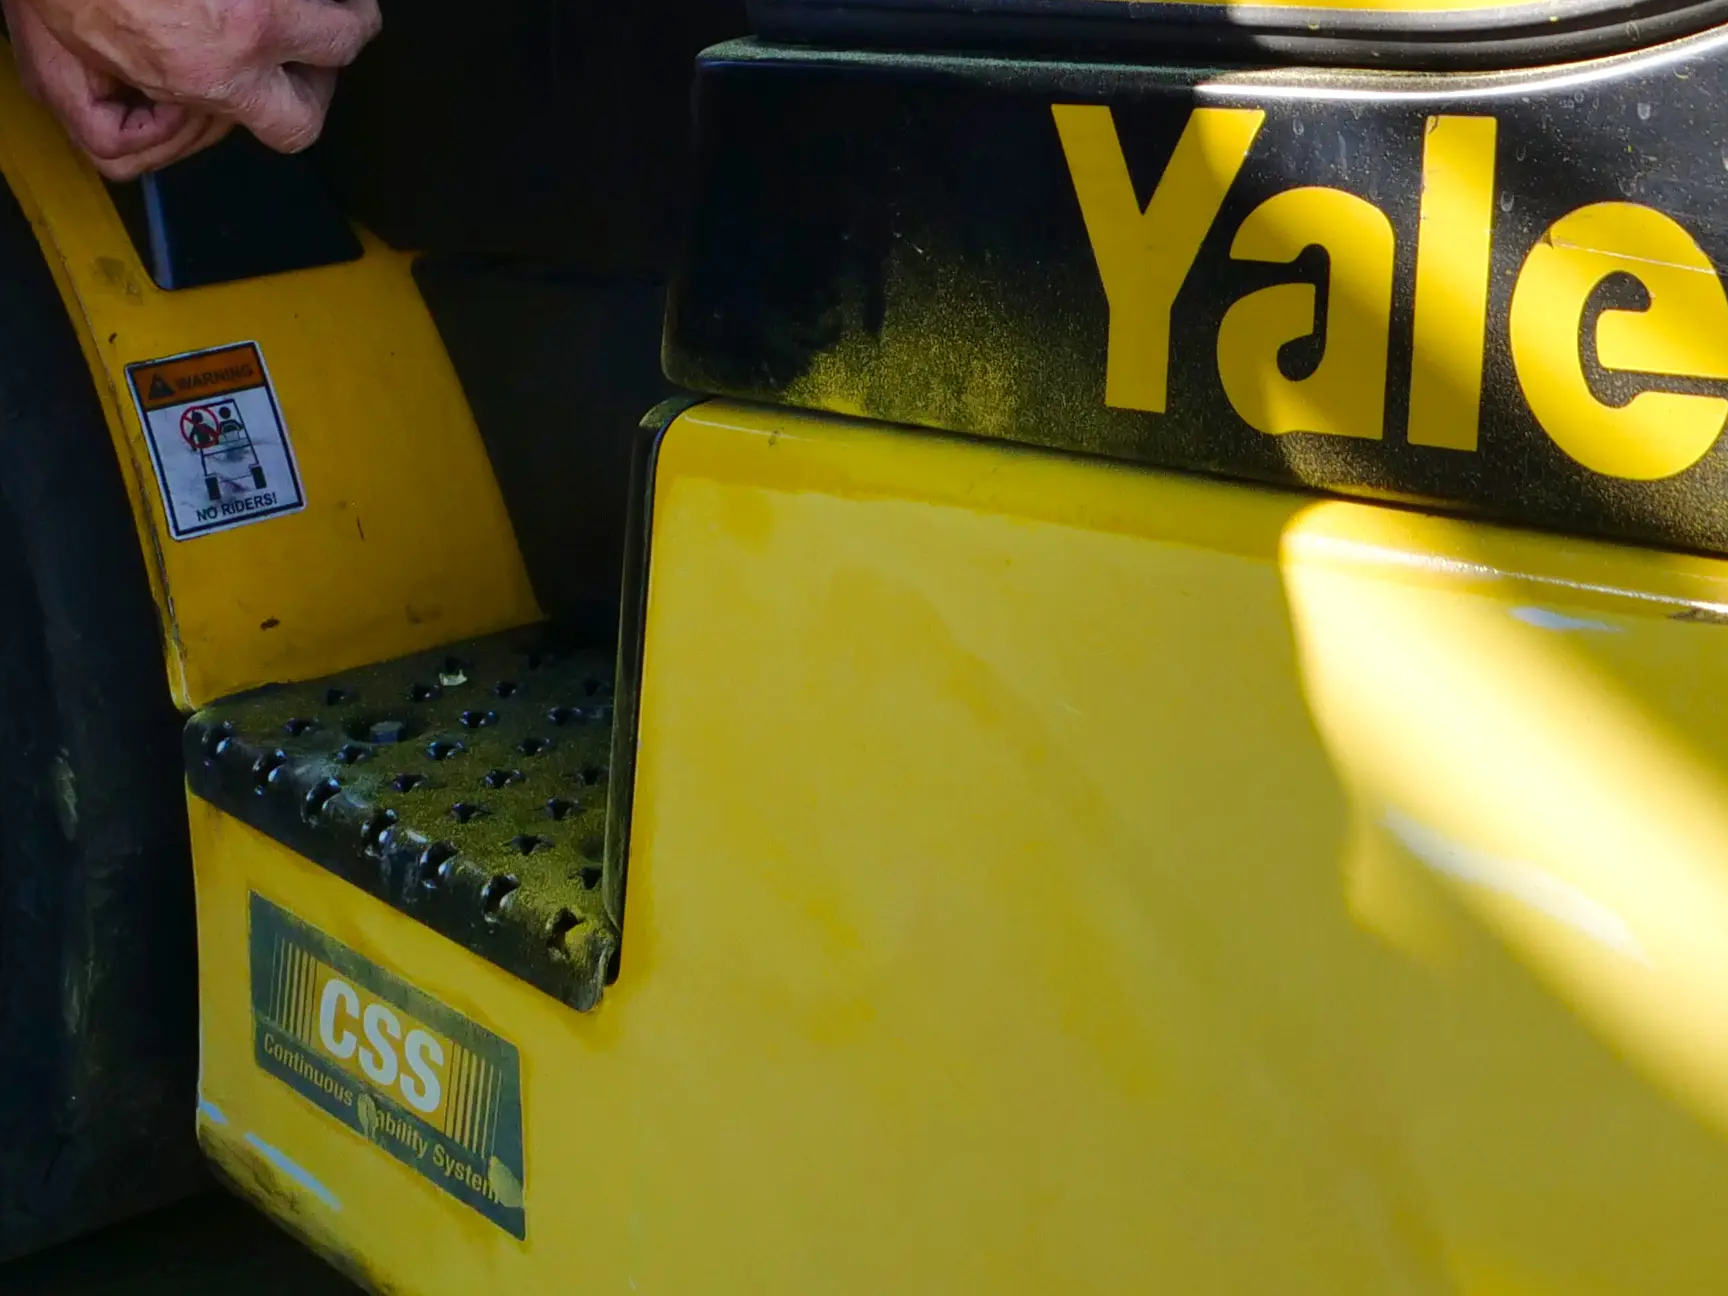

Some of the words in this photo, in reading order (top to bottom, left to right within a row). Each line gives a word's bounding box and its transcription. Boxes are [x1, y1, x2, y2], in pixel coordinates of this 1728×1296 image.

[176, 364, 254, 390] WARNING
[196, 504, 218, 522] NO
[222, 491, 278, 516] RIDERS!
[319, 978, 444, 1114] CSS
[263, 1031, 353, 1107] Continuous
[361, 1094, 428, 1158] ability
